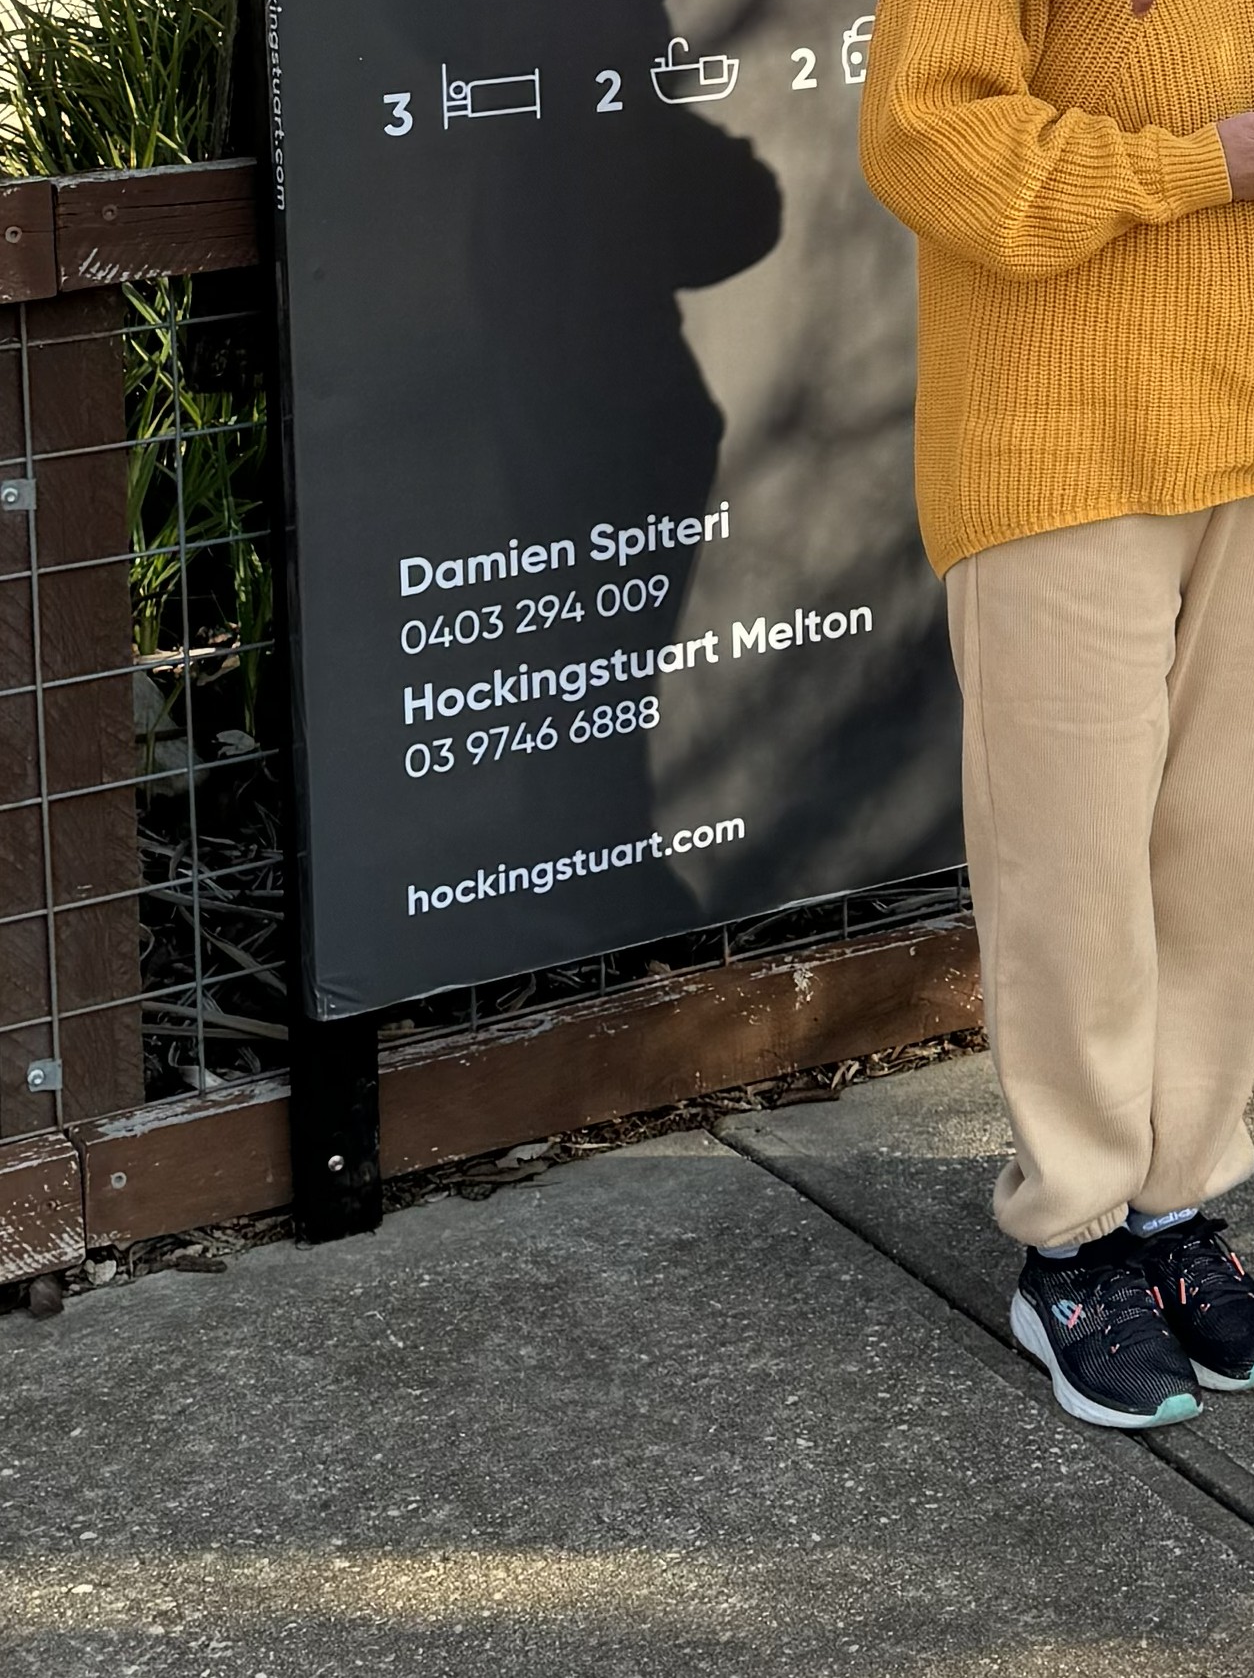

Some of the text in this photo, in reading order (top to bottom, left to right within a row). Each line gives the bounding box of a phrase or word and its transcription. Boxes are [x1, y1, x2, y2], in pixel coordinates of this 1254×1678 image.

[383, 47, 818, 137] 3 2 2
[400, 501, 730, 597] Damien Spiteri
[400, 574, 669, 655] 0403 294 009
[404, 606, 873, 725] Hockingstuart Melton
[405, 695, 660, 778] 03 9746 6888
[407, 817, 745, 916] hockingstuart.com
